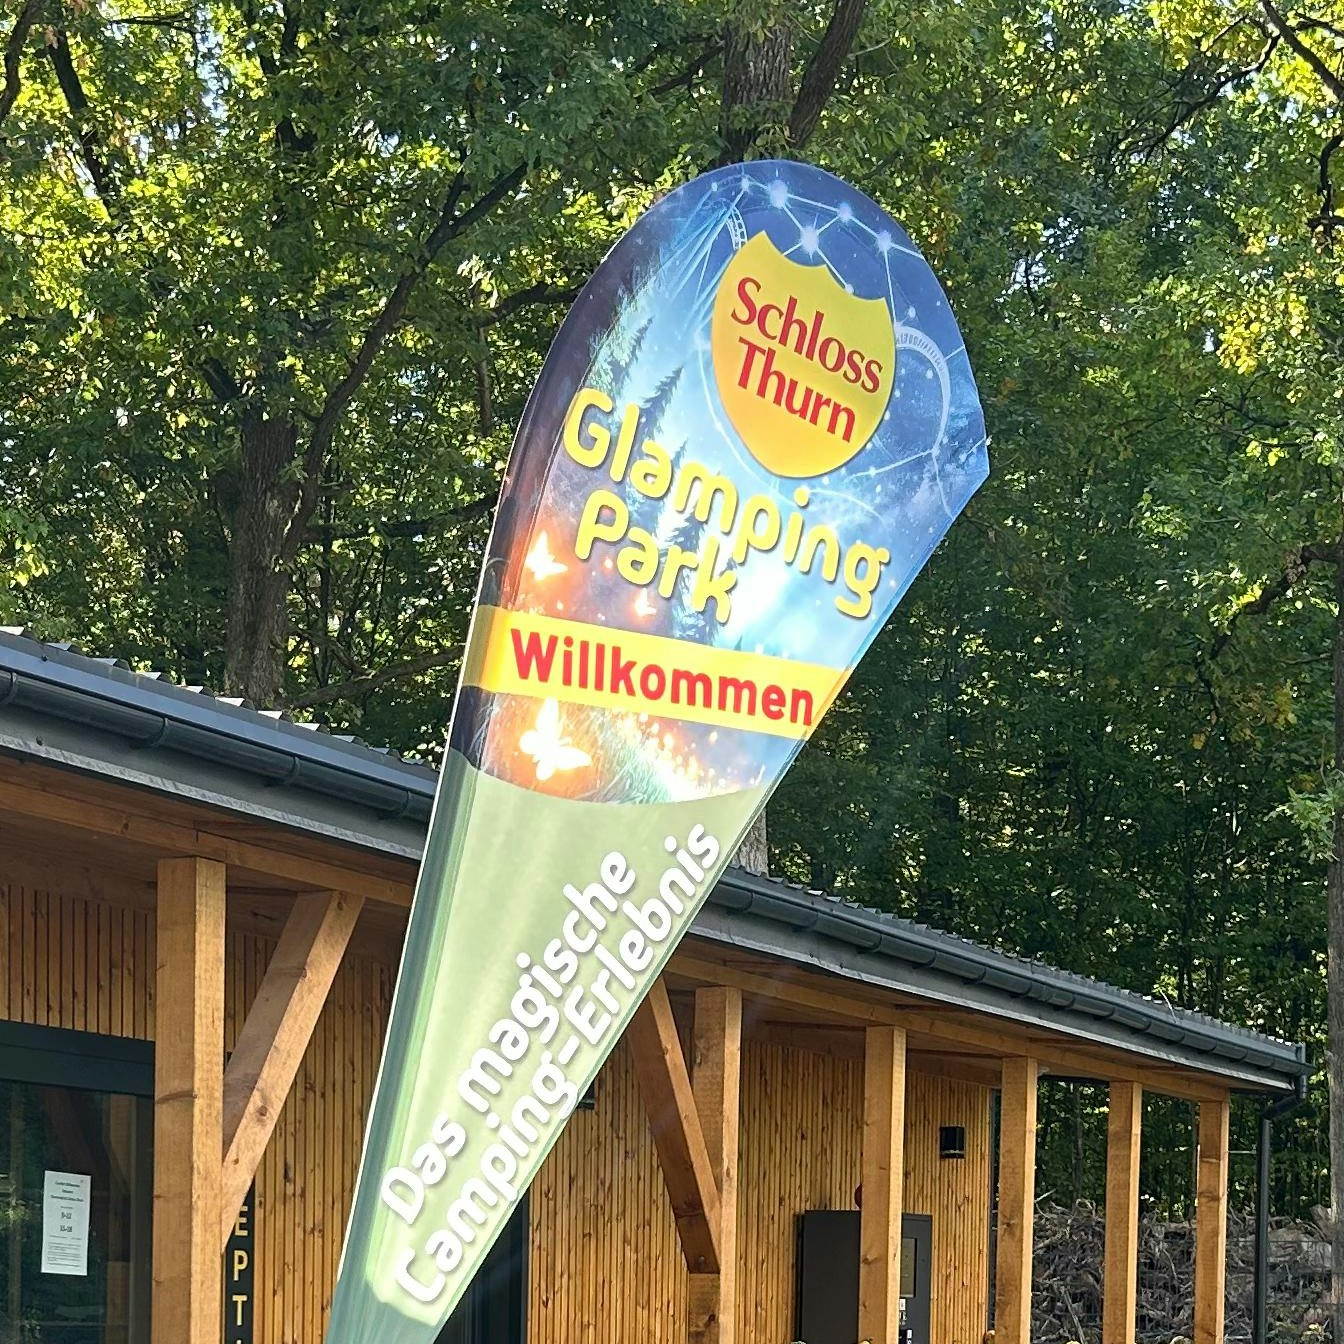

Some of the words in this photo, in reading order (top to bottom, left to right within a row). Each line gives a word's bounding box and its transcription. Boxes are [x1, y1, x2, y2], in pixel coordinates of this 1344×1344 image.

[730, 277, 883, 394] Schloss
[738, 337, 856, 443] Thurn
[562, 388, 891, 620] Glamping
[574, 489, 739, 624] Park
[510, 628, 815, 727] Willkommen
[382, 1112, 467, 1225] Das
[458, 850, 637, 1114] magische
[395, 823, 722, 1302] Camping-Erlebnis
